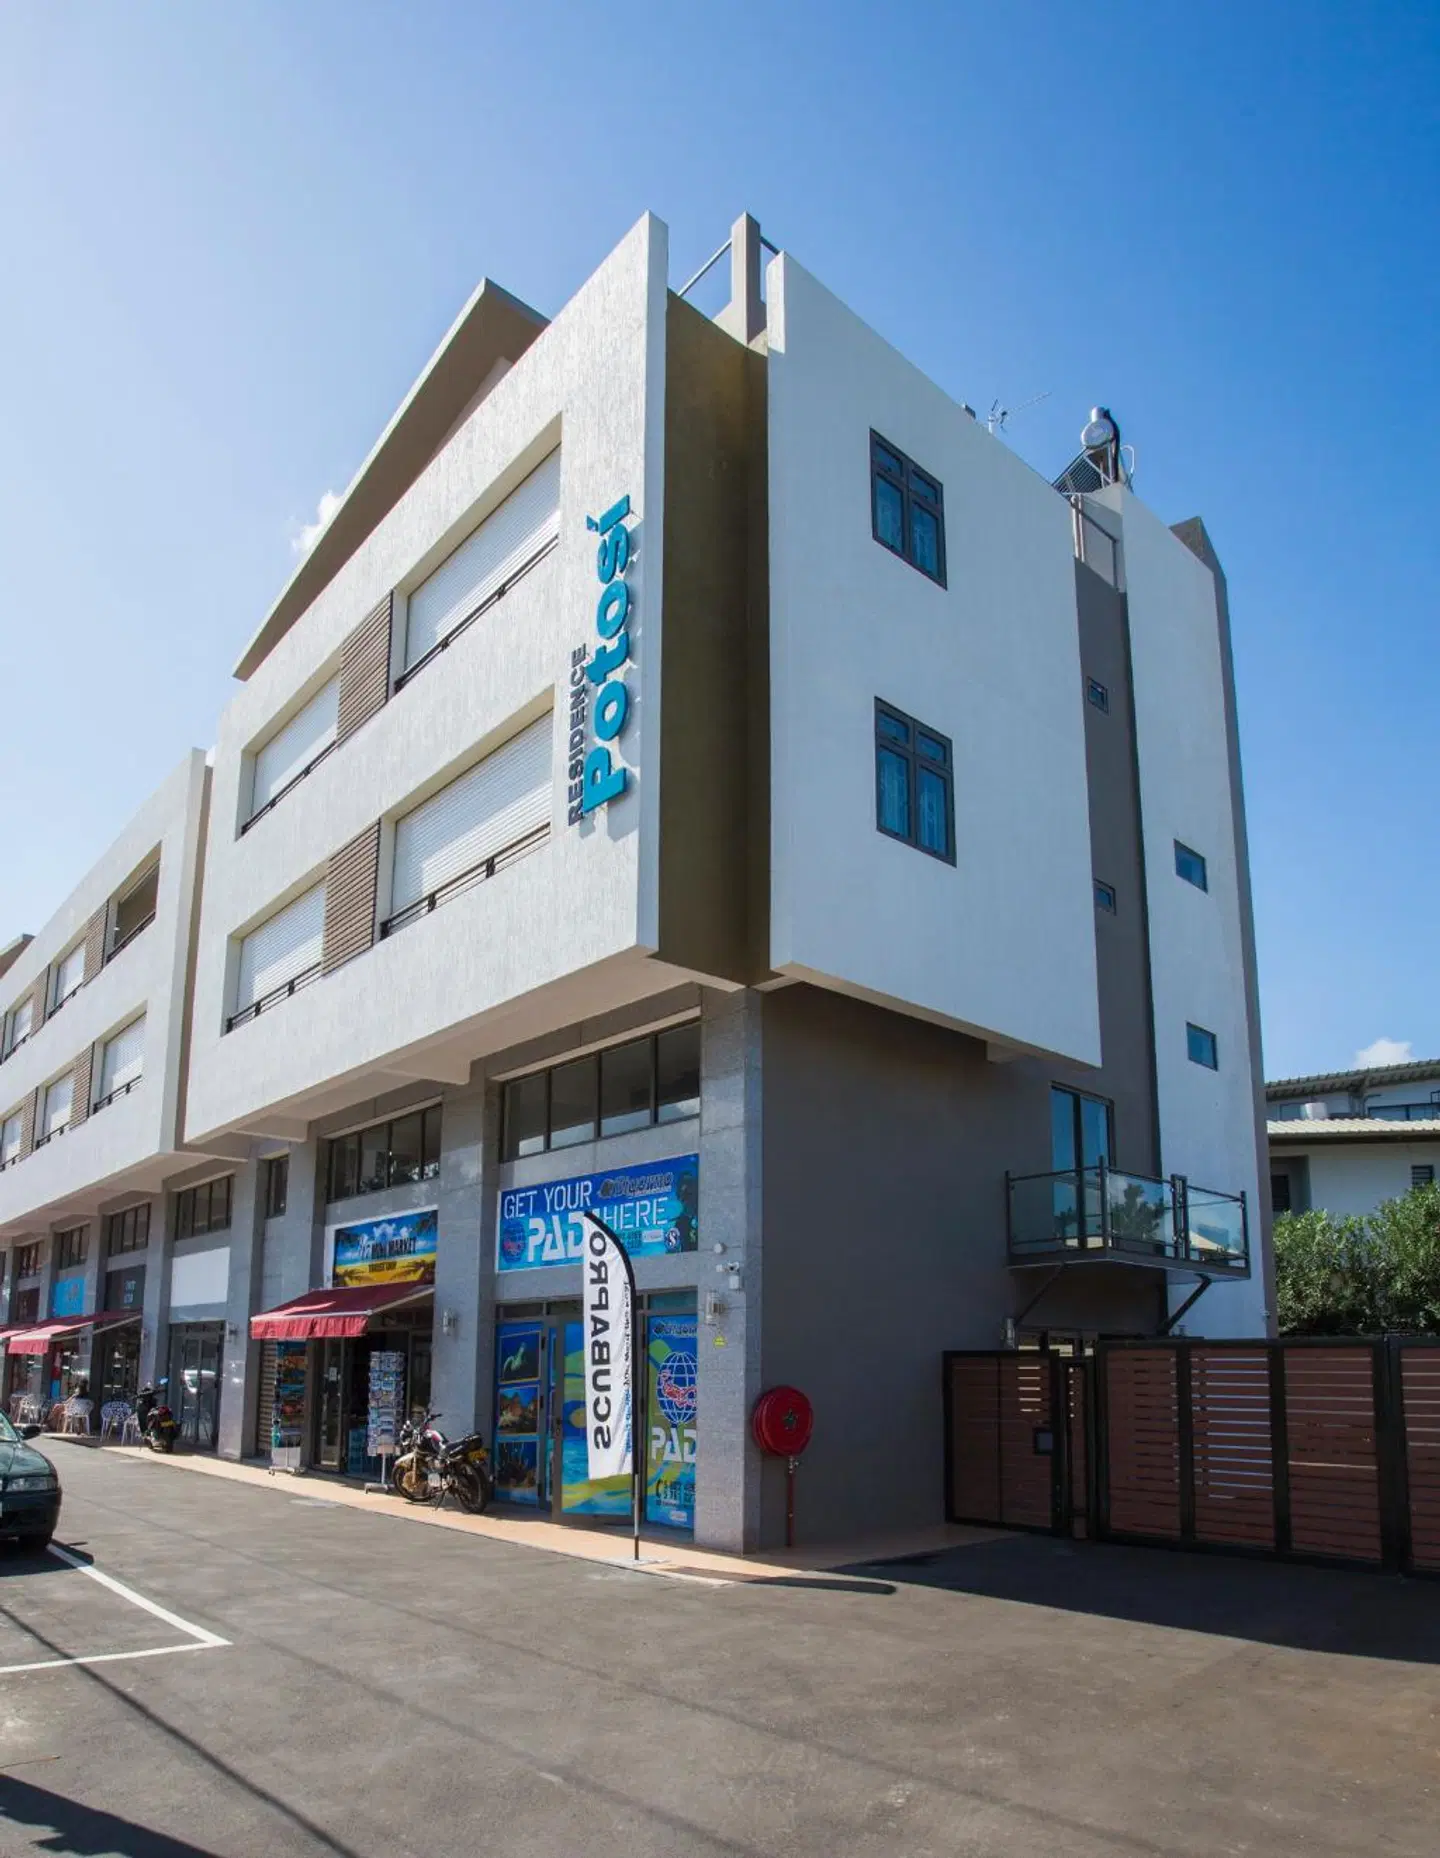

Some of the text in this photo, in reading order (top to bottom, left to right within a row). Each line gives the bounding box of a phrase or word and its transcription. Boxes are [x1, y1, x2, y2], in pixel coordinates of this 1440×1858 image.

[568, 643, 586, 826] RESIDENCE
[504, 1190, 537, 1219] GET
[544, 1180, 592, 1212] YOUR
[604, 1197, 668, 1231] HERE
